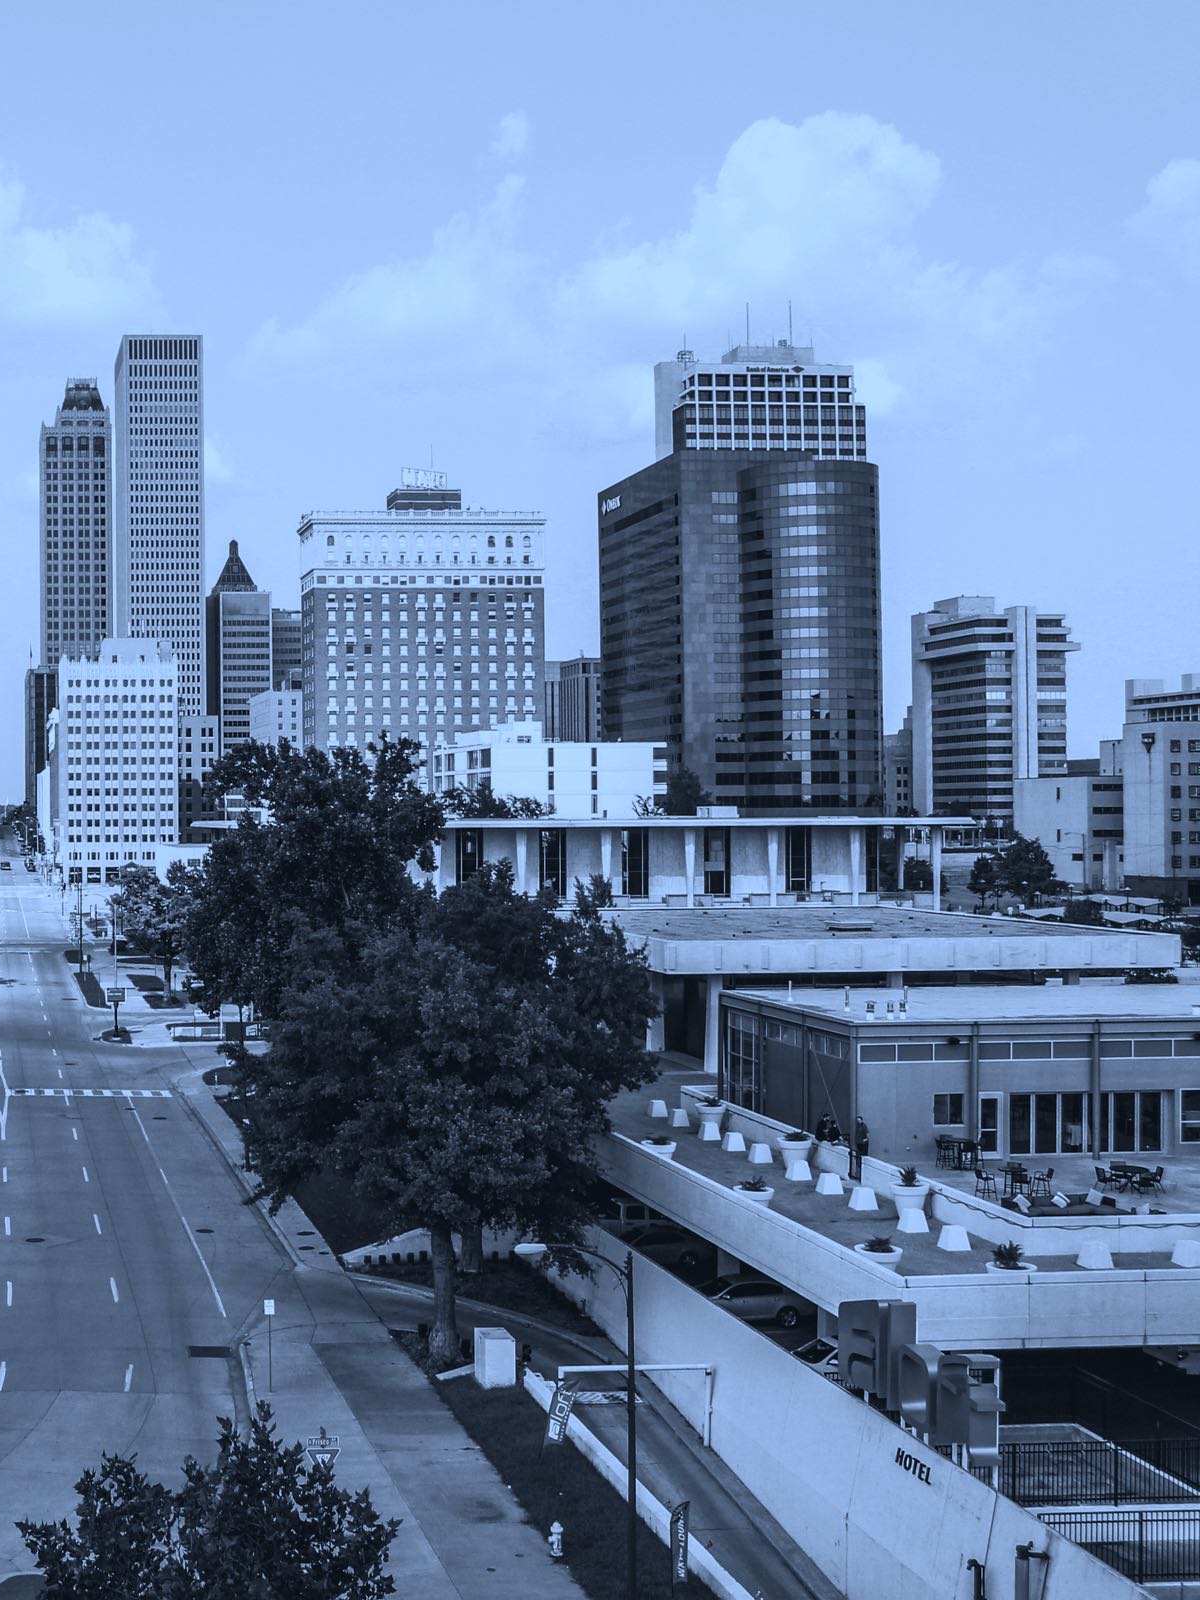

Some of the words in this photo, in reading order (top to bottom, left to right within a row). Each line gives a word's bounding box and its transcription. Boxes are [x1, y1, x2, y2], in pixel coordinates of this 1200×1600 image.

[838, 1299, 1006, 1467] aloft
[548, 1389, 573, 1441] aloft
[895, 1447, 932, 1485] HOTEL
